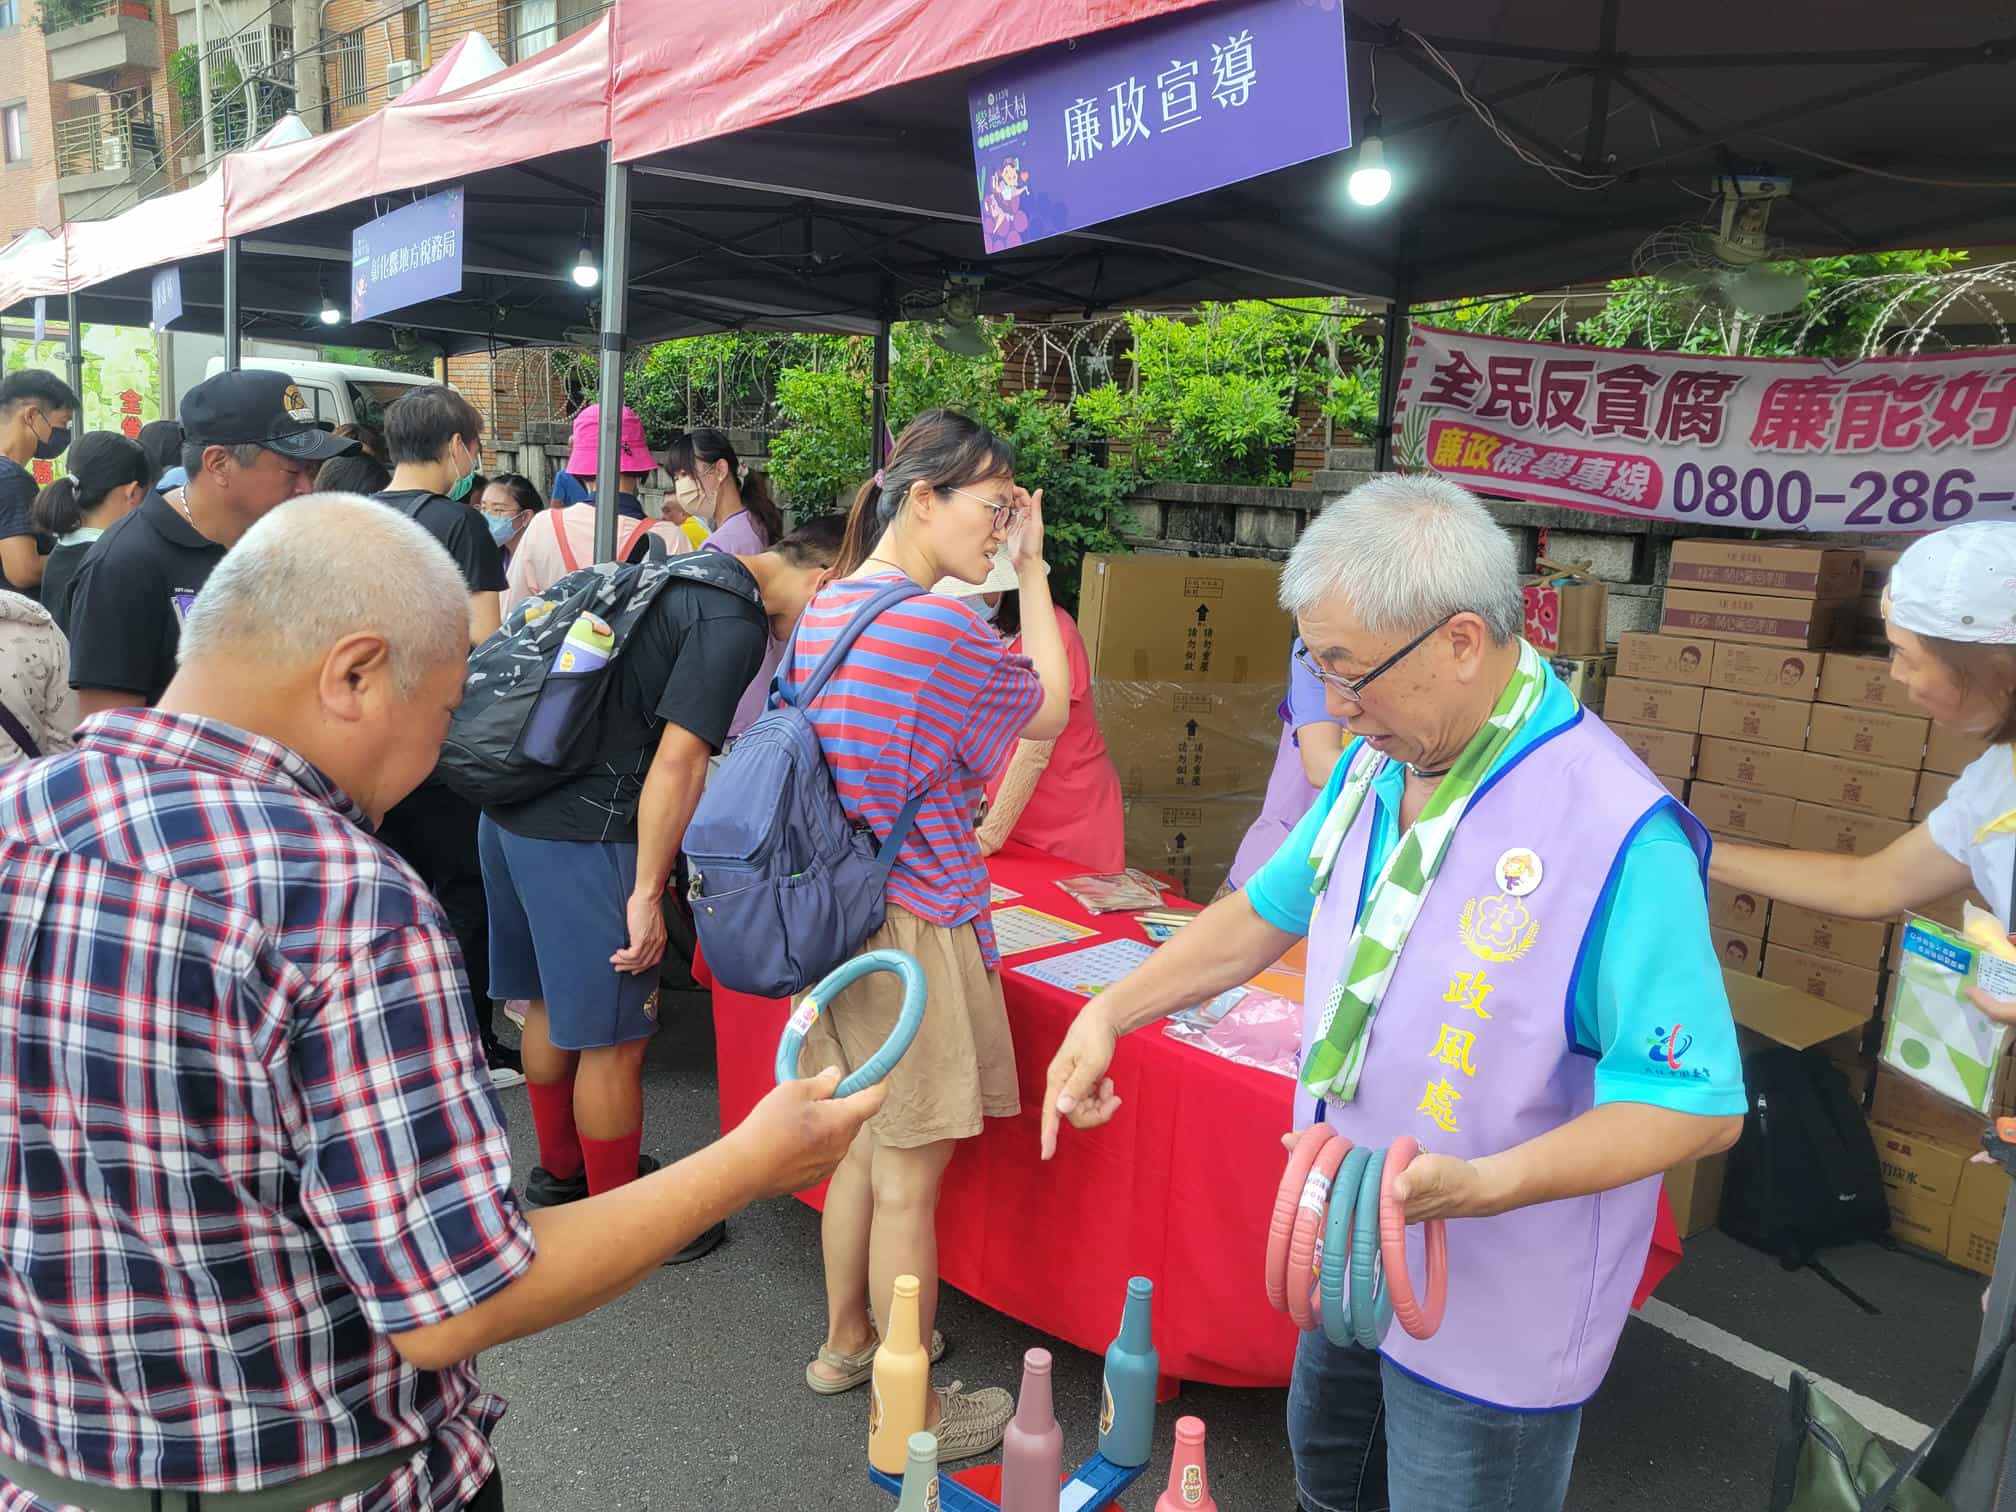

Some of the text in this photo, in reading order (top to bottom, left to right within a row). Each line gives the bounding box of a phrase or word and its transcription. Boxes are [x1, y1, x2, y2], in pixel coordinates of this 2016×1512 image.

[1063, 29, 1257, 168] 廉政宣導
[1420, 350, 2016, 453] 全民反貪腐 廉能好
[1432, 427, 1651, 501] 廉政檢舉專線
[1673, 462, 2016, 525] 0800-286-
[1416, 969, 1495, 1133] 政風處
